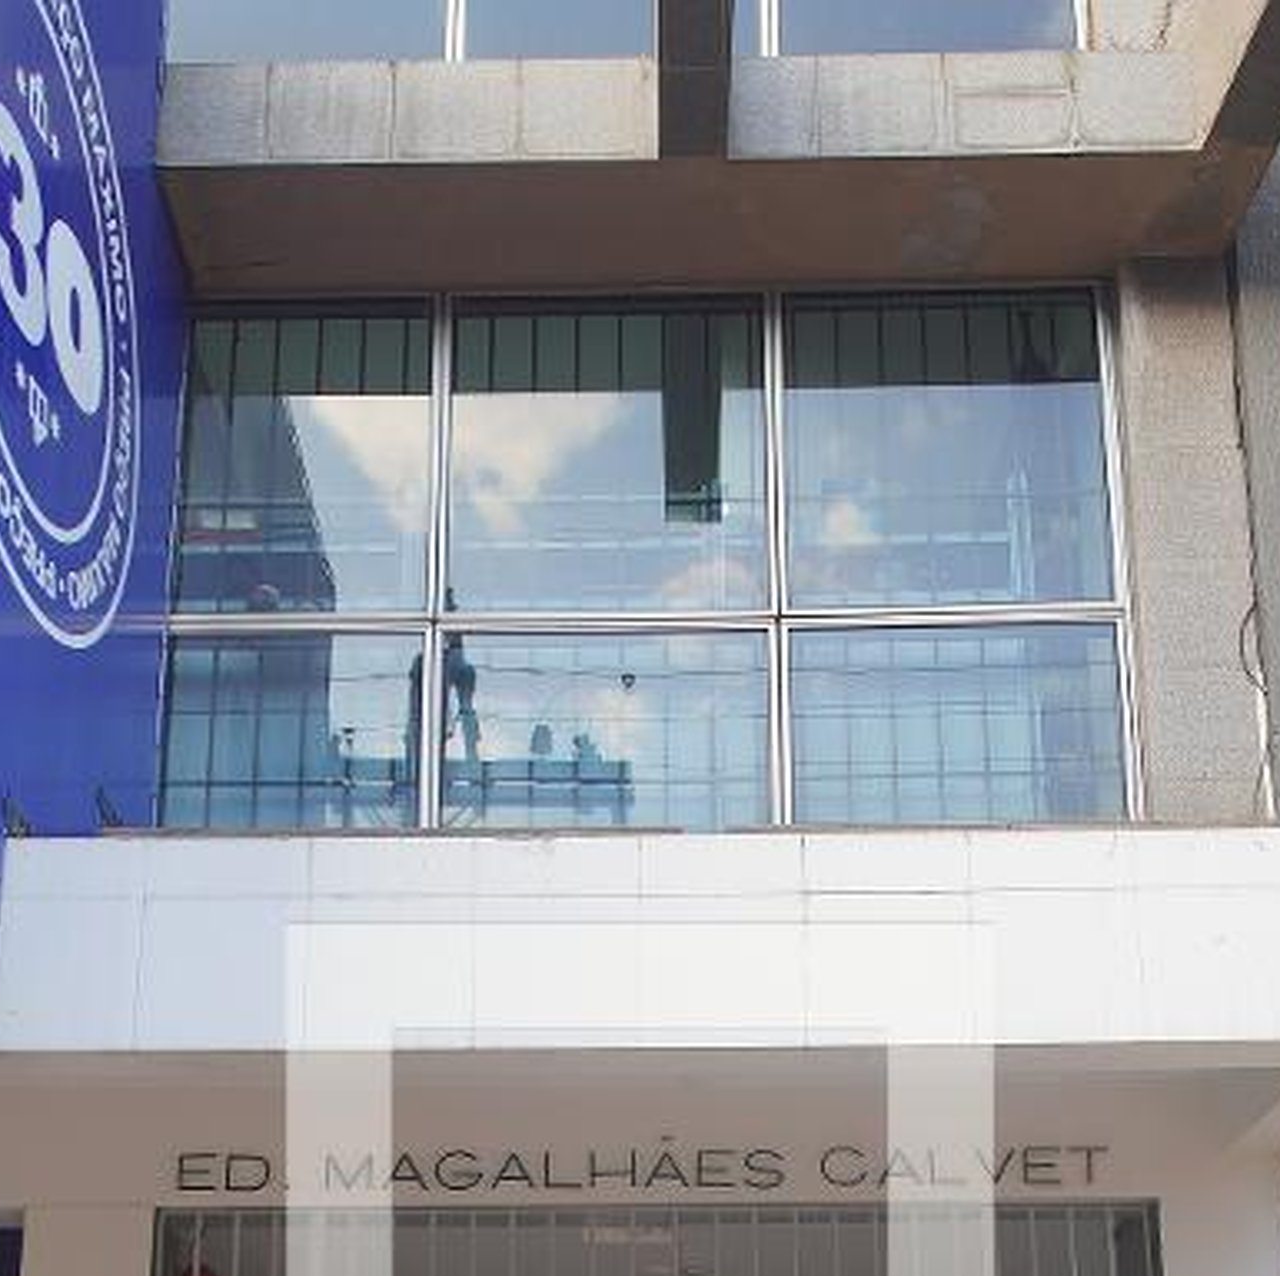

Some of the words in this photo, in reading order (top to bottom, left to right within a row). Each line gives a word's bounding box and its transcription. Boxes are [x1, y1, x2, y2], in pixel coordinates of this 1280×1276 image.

[176, 1151, 290, 1192] ED.
[322, 1135, 790, 1192] MAGALHÃES
[818, 1144, 1109, 1189] CALVET
